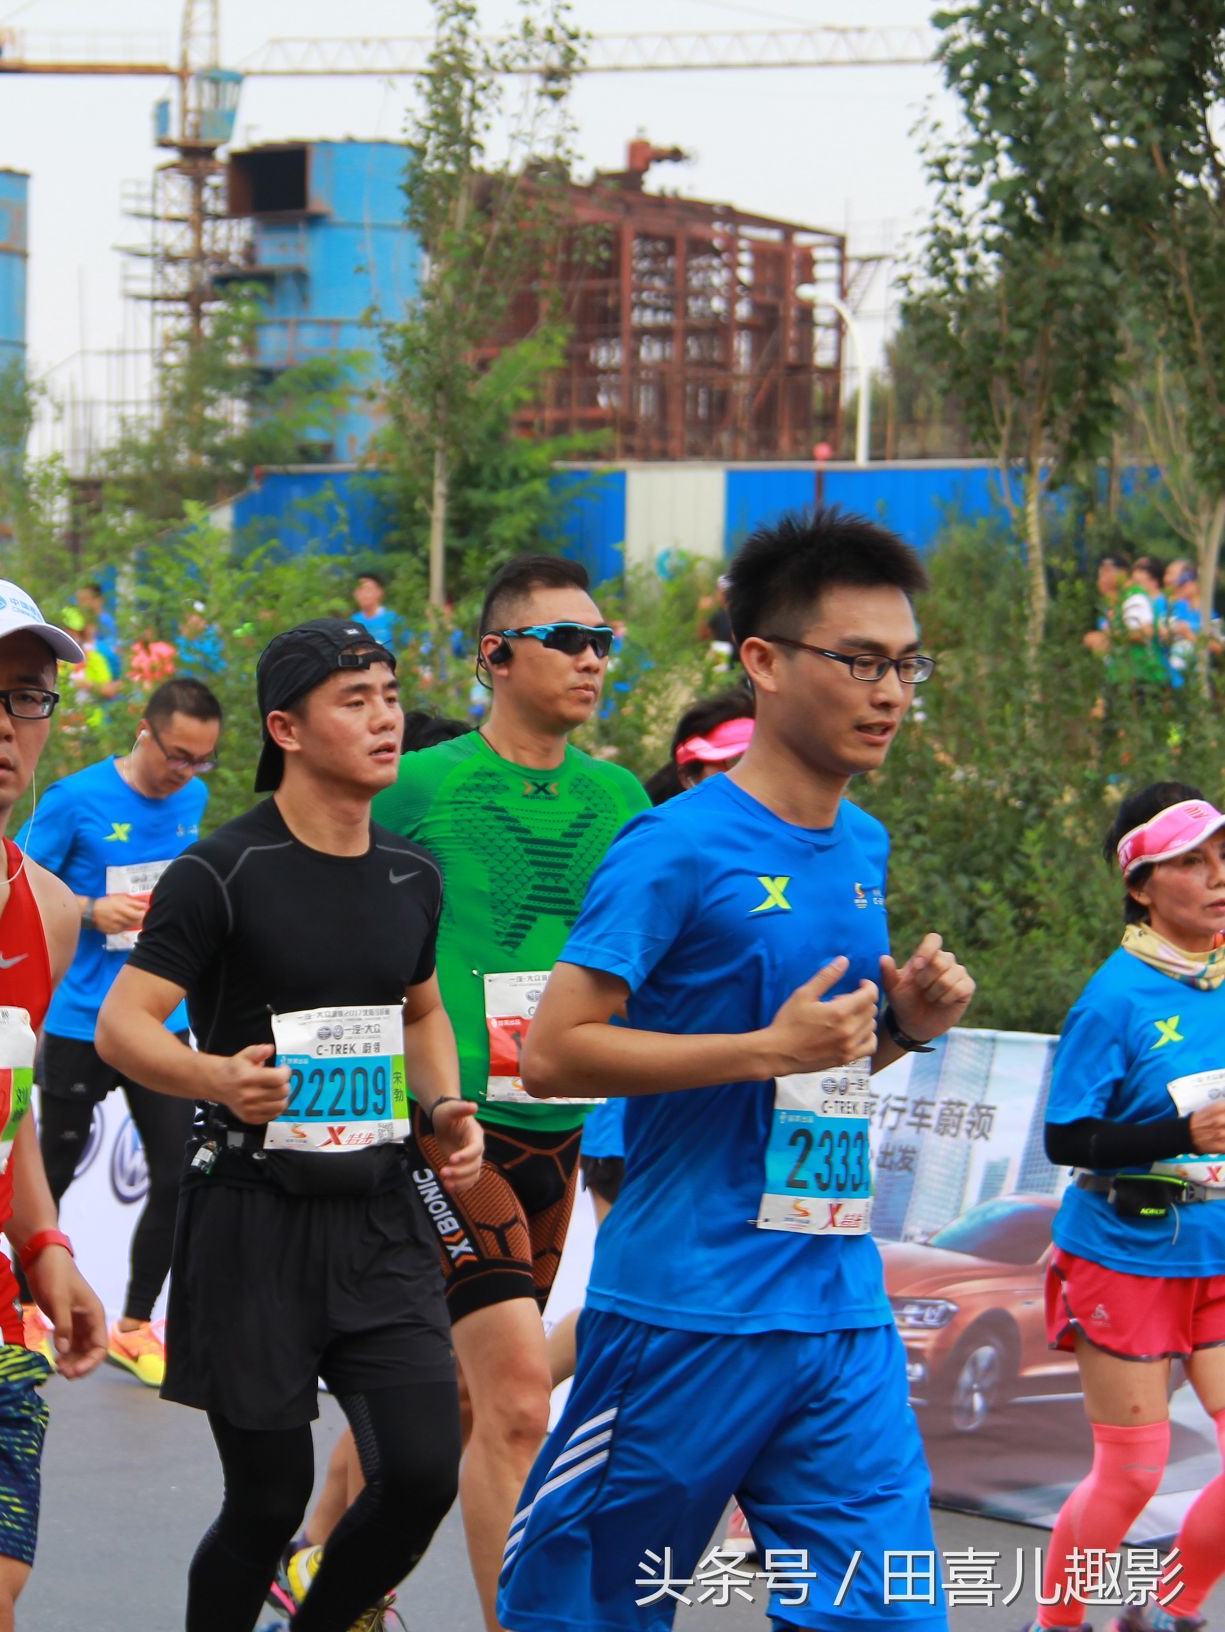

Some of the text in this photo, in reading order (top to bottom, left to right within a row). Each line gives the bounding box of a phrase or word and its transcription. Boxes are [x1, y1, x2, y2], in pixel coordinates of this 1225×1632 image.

[316, 1043, 356, 1056] C-TREK
[281, 1066, 387, 1117] 22209
[786, 1128, 869, 1192] 2333
